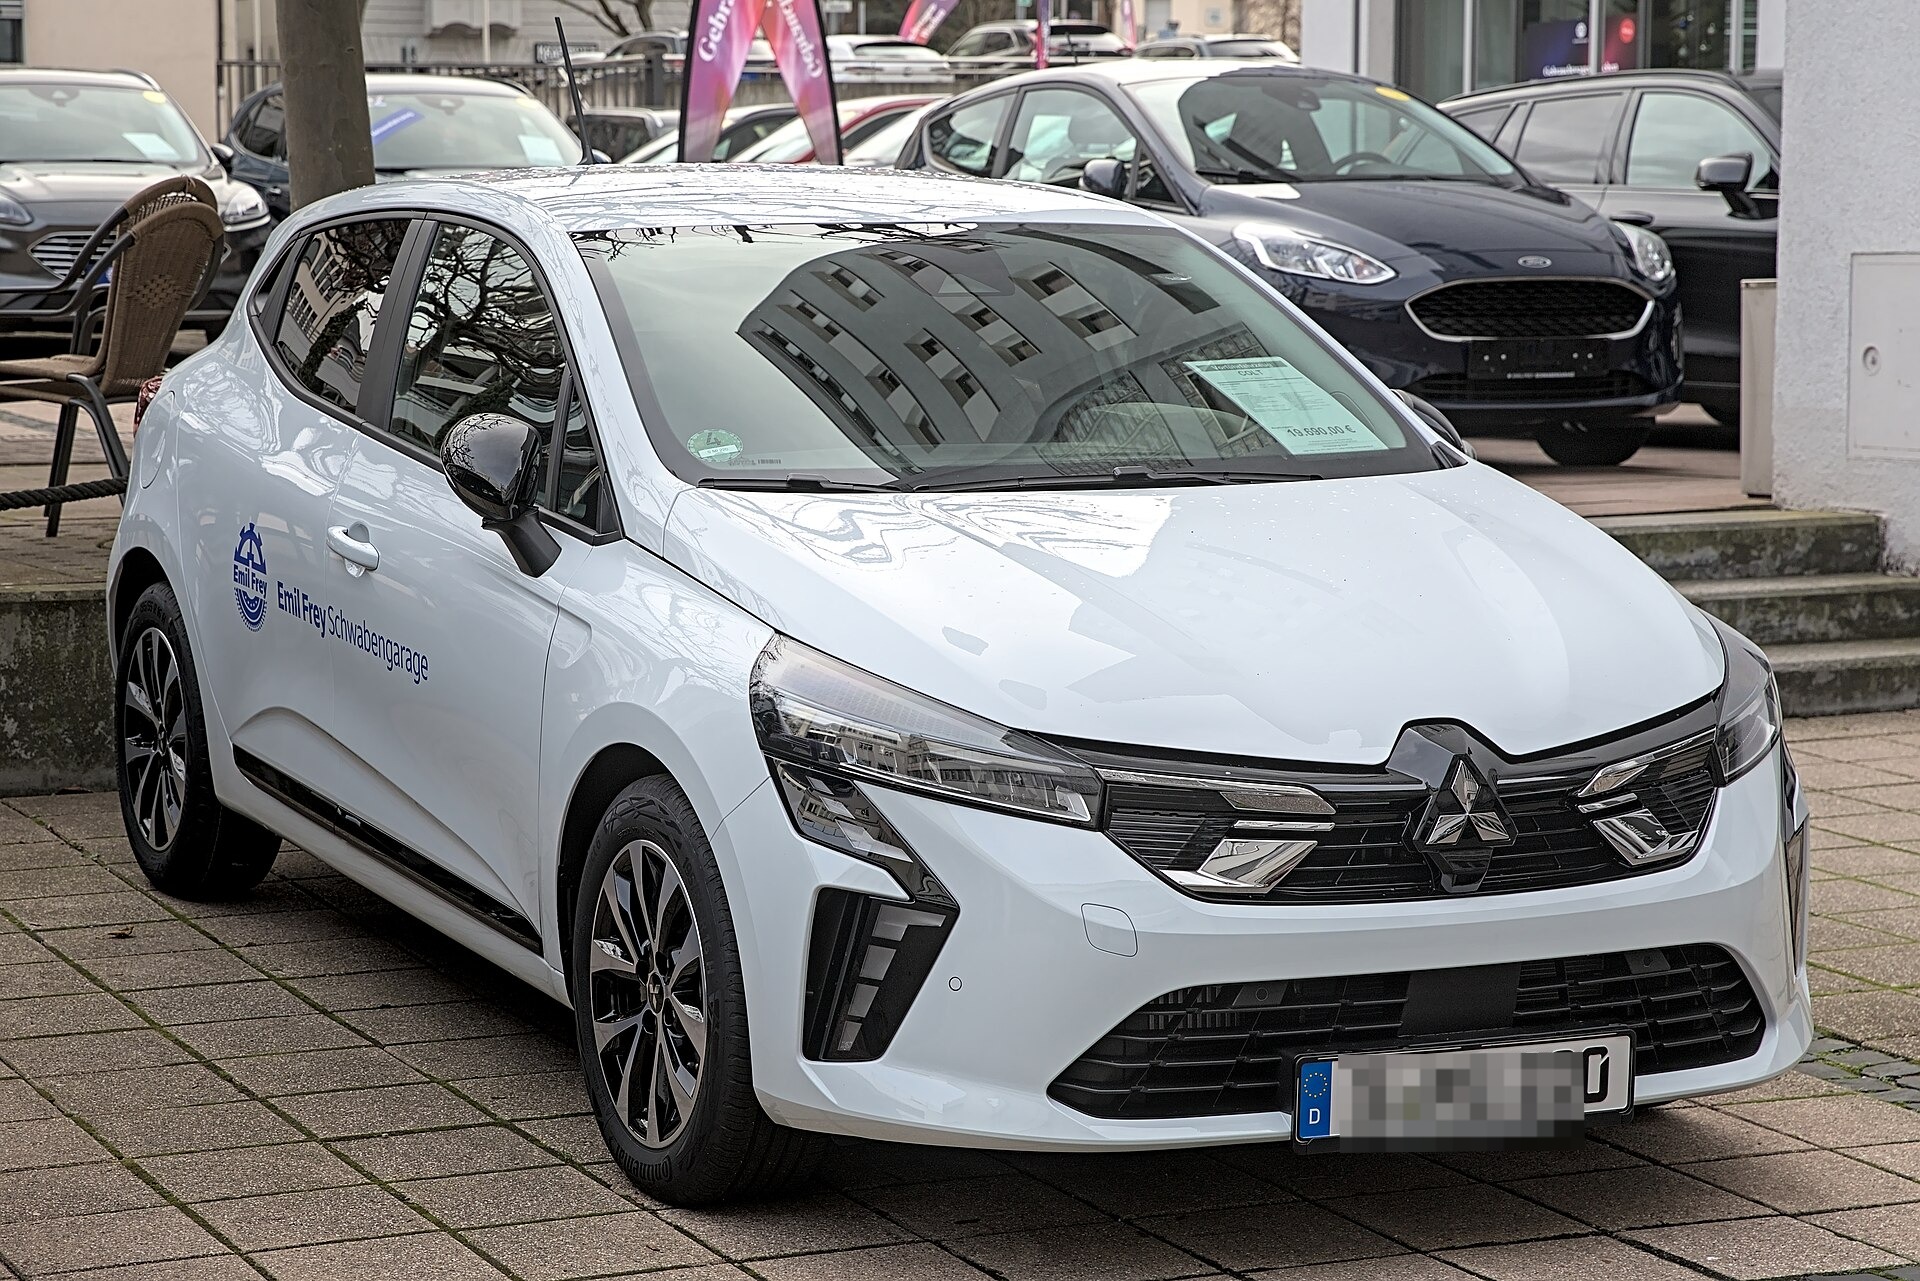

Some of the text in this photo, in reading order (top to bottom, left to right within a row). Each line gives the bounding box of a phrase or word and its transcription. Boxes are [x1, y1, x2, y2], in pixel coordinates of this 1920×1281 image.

[1237, 369, 1264, 377] COLT
[1345, 424, 1356, 434] €
[233, 564, 268, 599] Emil Frey
[277, 581, 429, 685] Emil Frey Schwabengarage
[1308, 1107, 1321, 1125] D
